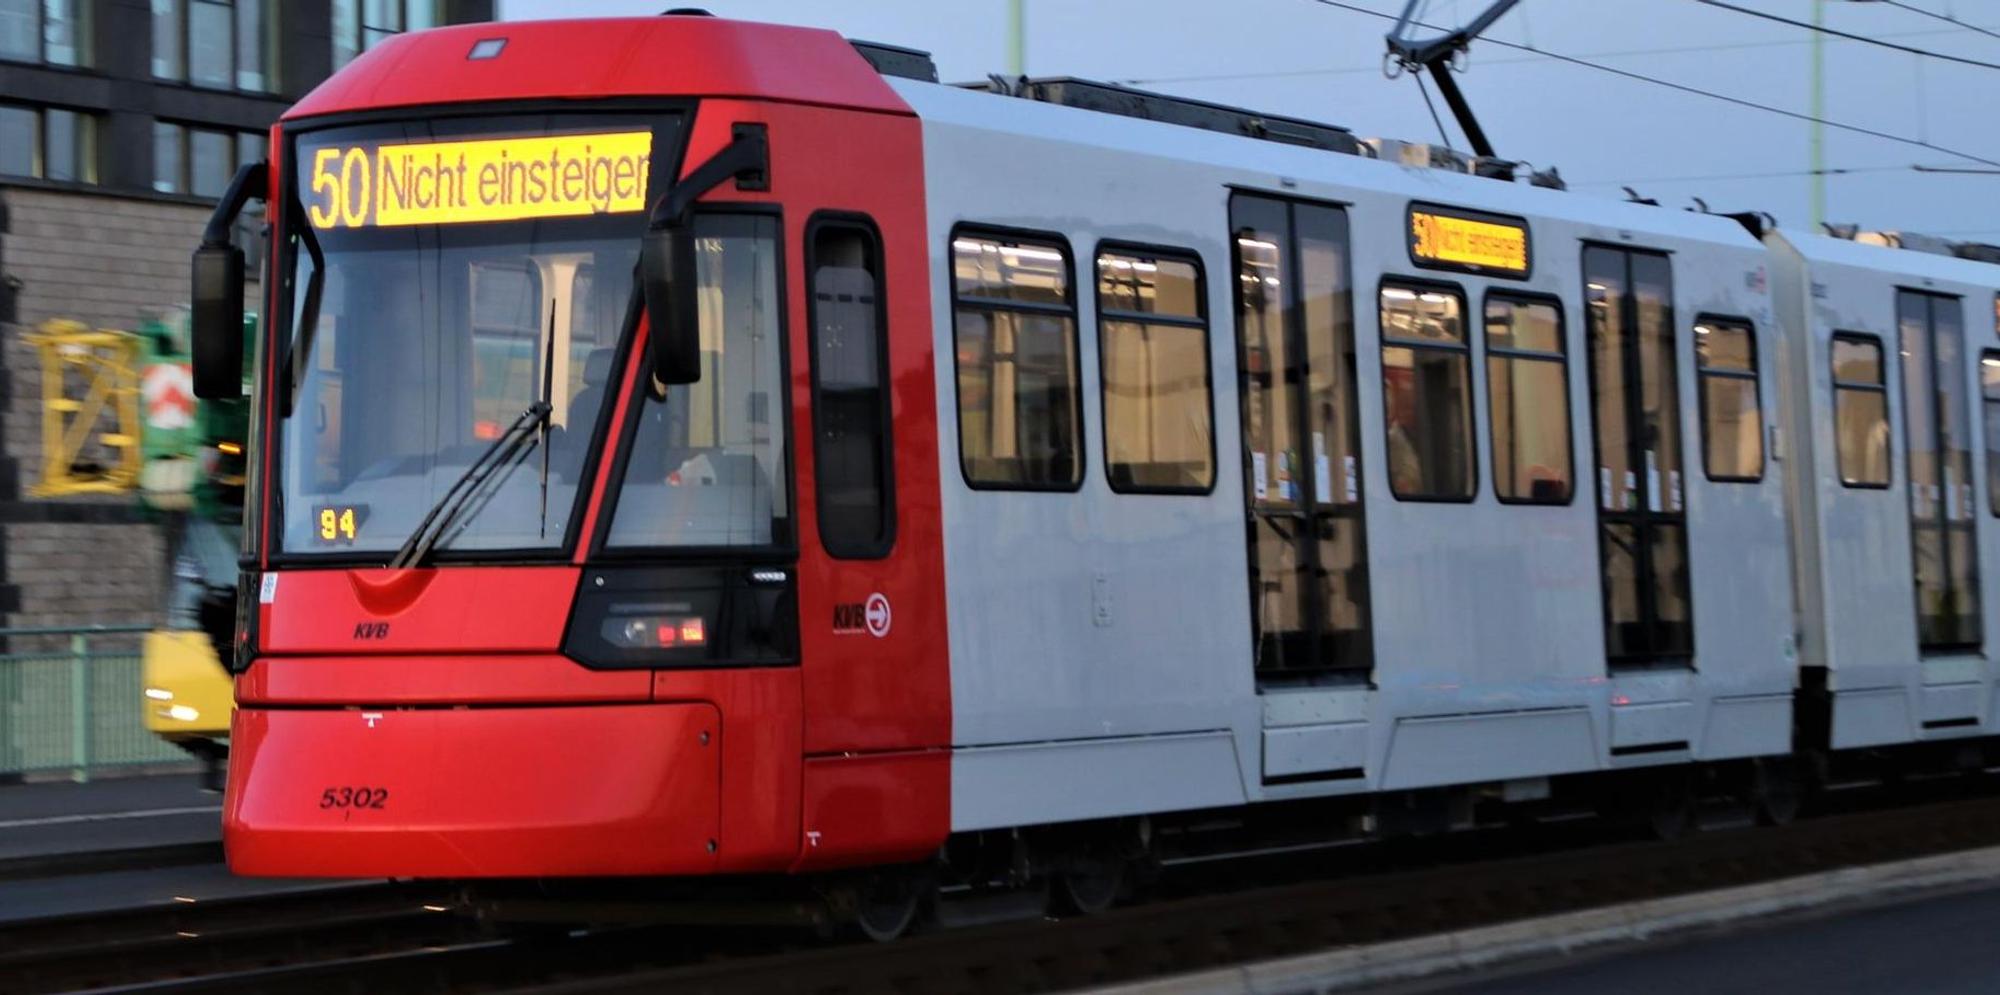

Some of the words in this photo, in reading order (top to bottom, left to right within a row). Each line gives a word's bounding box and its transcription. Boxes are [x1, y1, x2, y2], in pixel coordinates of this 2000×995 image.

[311, 147, 371, 228] 50
[381, 151, 467, 210] Nicht
[321, 508, 355, 540] 94
[833, 603, 866, 629] KVB
[353, 622, 390, 640] KVB
[319, 786, 389, 810] 5302
